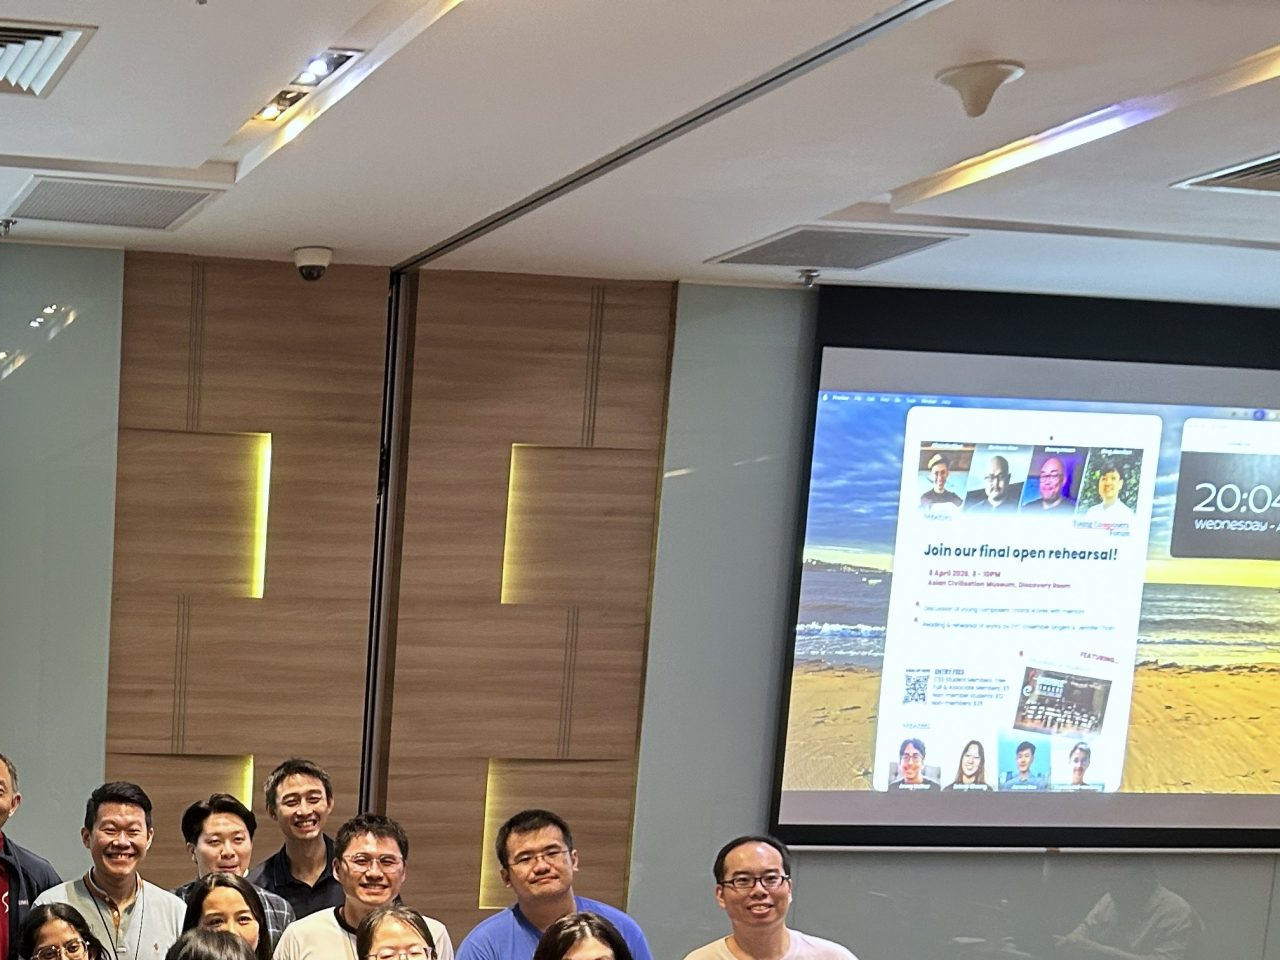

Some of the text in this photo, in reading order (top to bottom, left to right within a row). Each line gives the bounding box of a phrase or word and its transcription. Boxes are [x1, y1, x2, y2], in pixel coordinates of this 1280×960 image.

[924, 543, 1118, 562] Join our final open rehearsal!
